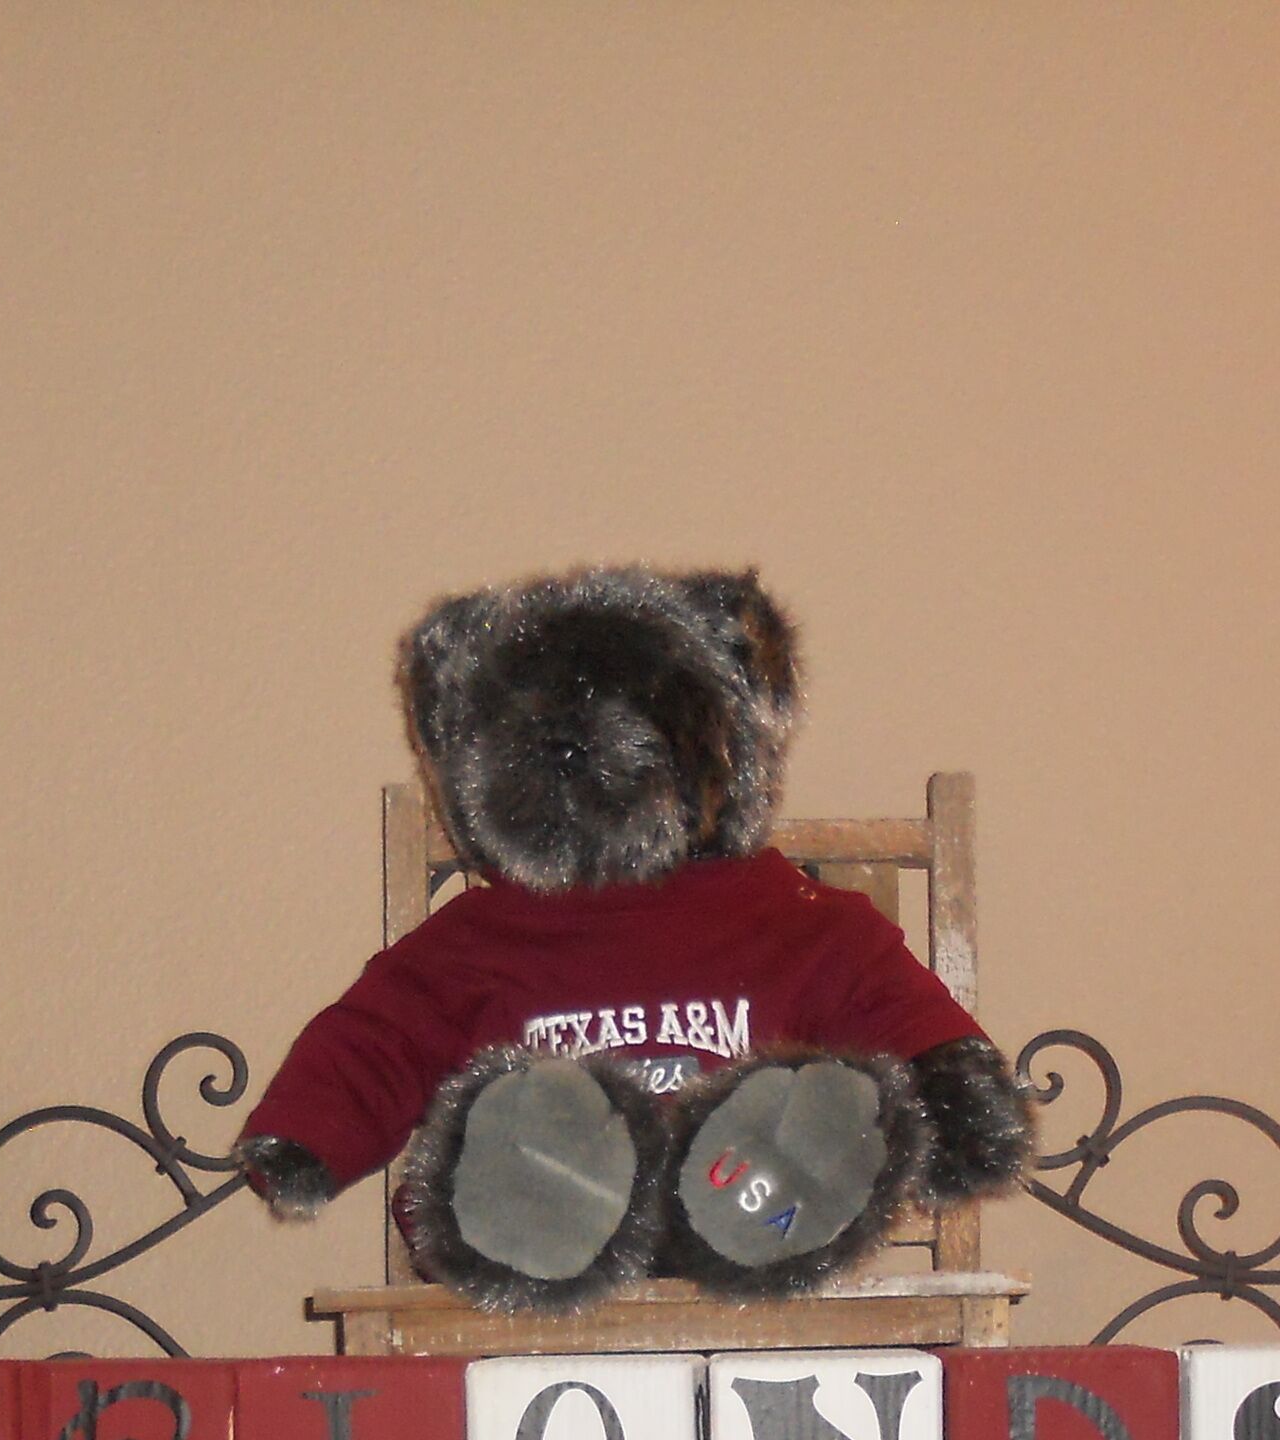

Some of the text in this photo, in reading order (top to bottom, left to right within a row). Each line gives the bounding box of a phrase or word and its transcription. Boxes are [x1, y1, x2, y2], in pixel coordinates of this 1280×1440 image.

[524, 998, 750, 1059] TEXAS A&M
[707, 1147, 801, 1240] USA
